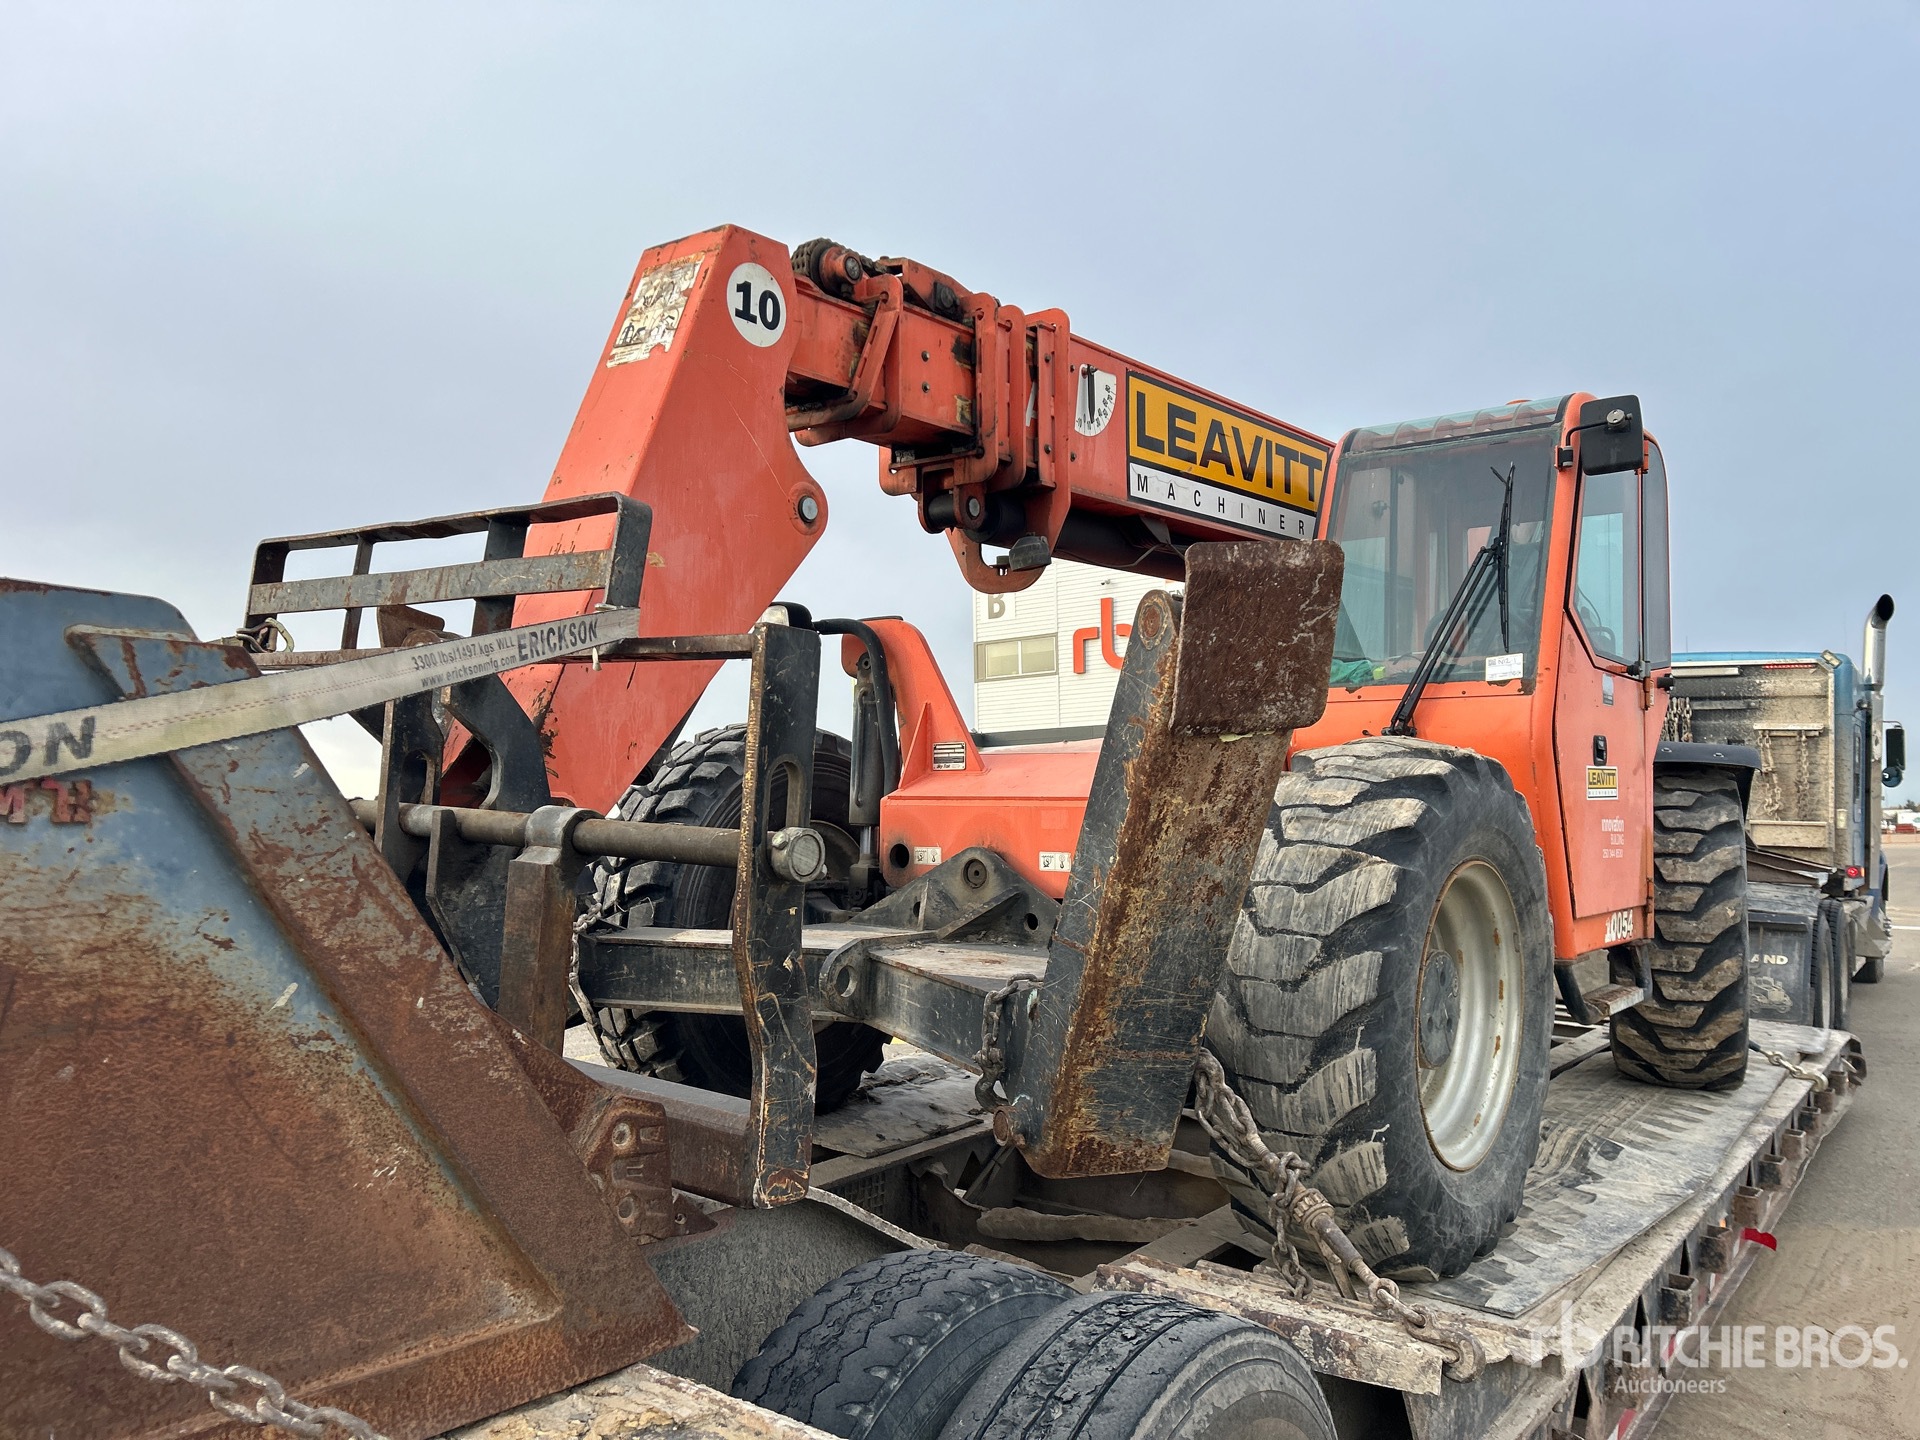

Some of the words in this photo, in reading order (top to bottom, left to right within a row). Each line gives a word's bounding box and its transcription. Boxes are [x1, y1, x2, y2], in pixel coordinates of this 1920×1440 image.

[735, 280, 781, 331] 10
[1136, 391, 1323, 503] LEAVITT
[411, 652, 437, 671] 3300
[495, 636, 516, 650] WLL
[516, 616, 599, 662] ERICKSON
[1588, 772, 1616, 786] LEAVITT
